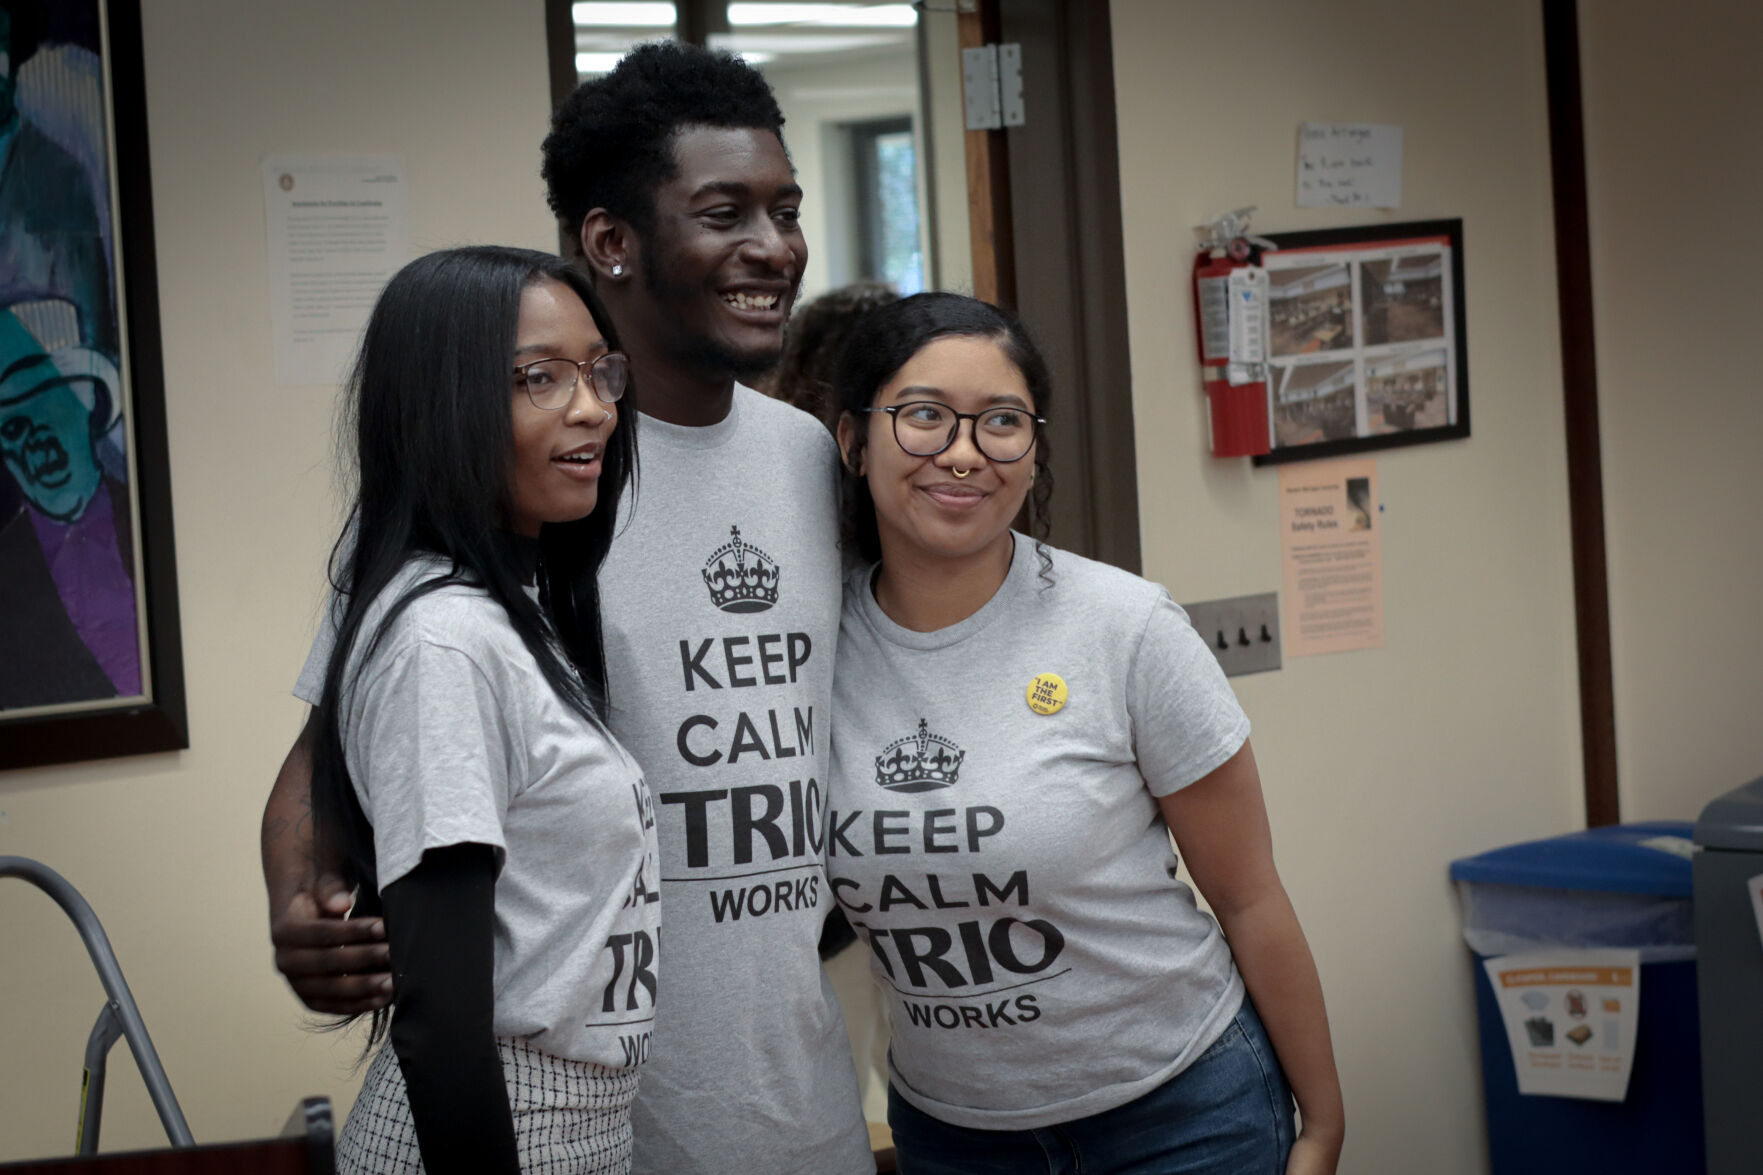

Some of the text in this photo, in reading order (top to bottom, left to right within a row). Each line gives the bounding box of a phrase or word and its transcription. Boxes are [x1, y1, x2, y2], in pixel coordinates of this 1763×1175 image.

[679, 632, 812, 692] KEEP
[1042, 680, 1058, 691] AM
[1035, 685, 1054, 697] THE
[677, 706, 815, 767] CALM
[659, 777, 824, 868] TRIO
[829, 805, 1006, 857] KEEP
[709, 875, 820, 923] WORKS
[831, 869, 1030, 914] CALM
[602, 926, 661, 1013] TR
[852, 916, 1066, 989] TRIO
[904, 994, 1042, 1030] WORKS
